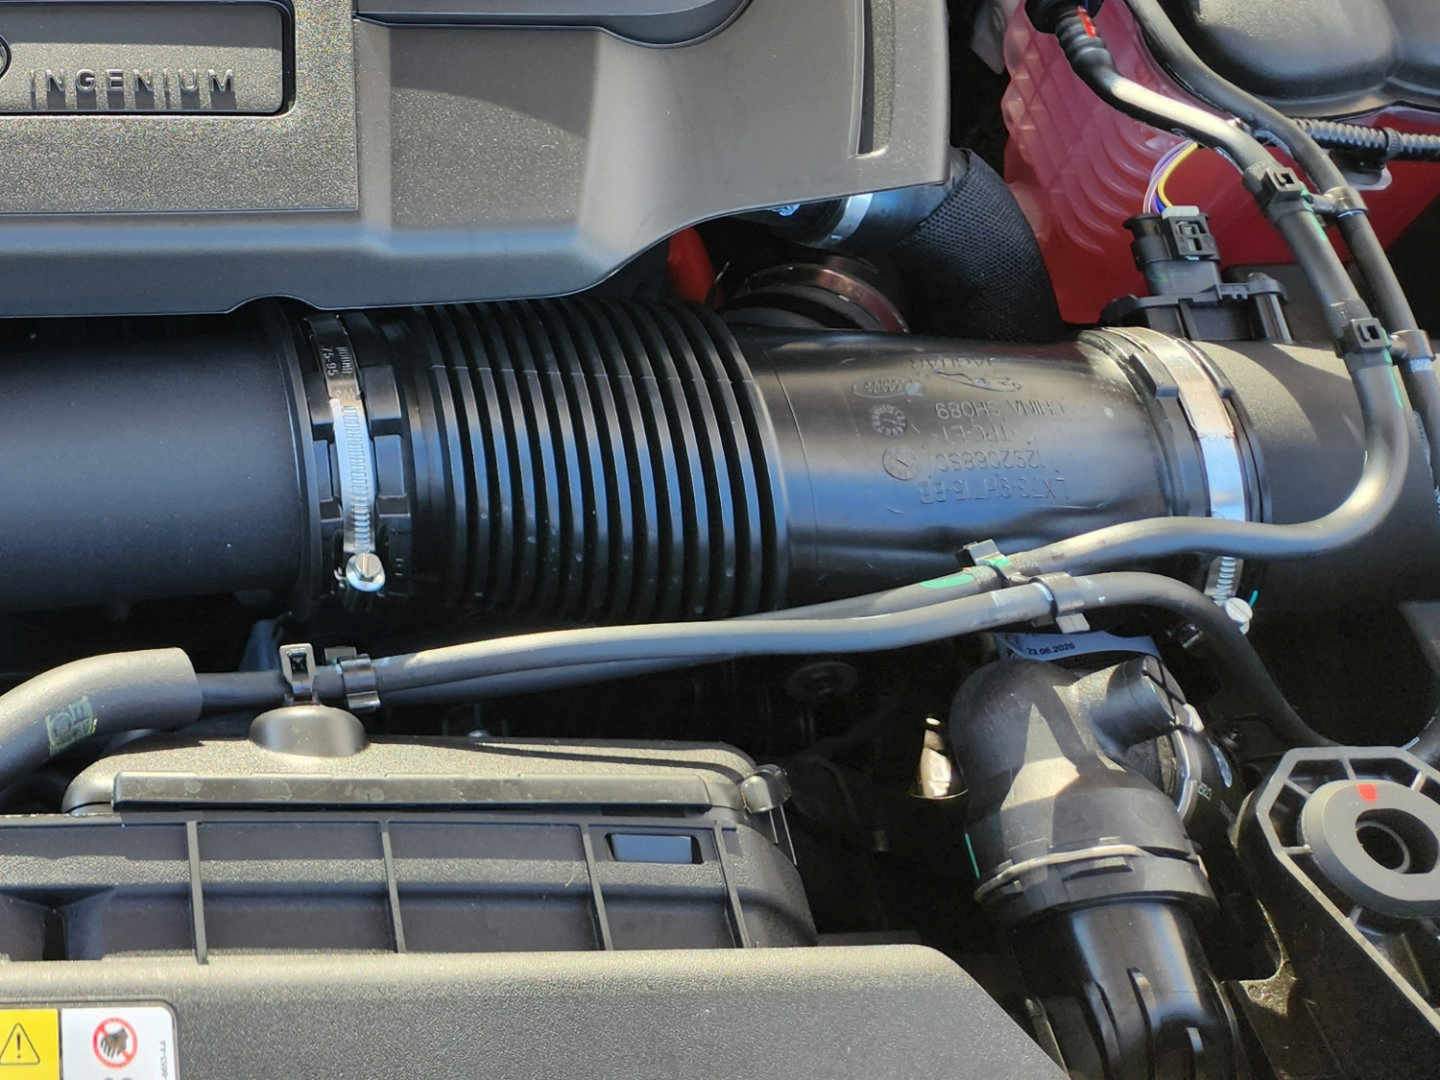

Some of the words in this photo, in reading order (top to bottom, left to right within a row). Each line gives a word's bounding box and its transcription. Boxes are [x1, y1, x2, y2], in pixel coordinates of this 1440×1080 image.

[29, 67, 237, 95] INGENIUM
[322, 345, 339, 377] 75-95
[910, 356, 994, 369] JAGUAR
[934, 400, 1001, 421] SH089
[1006, 399, 1066, 417] CHINA
